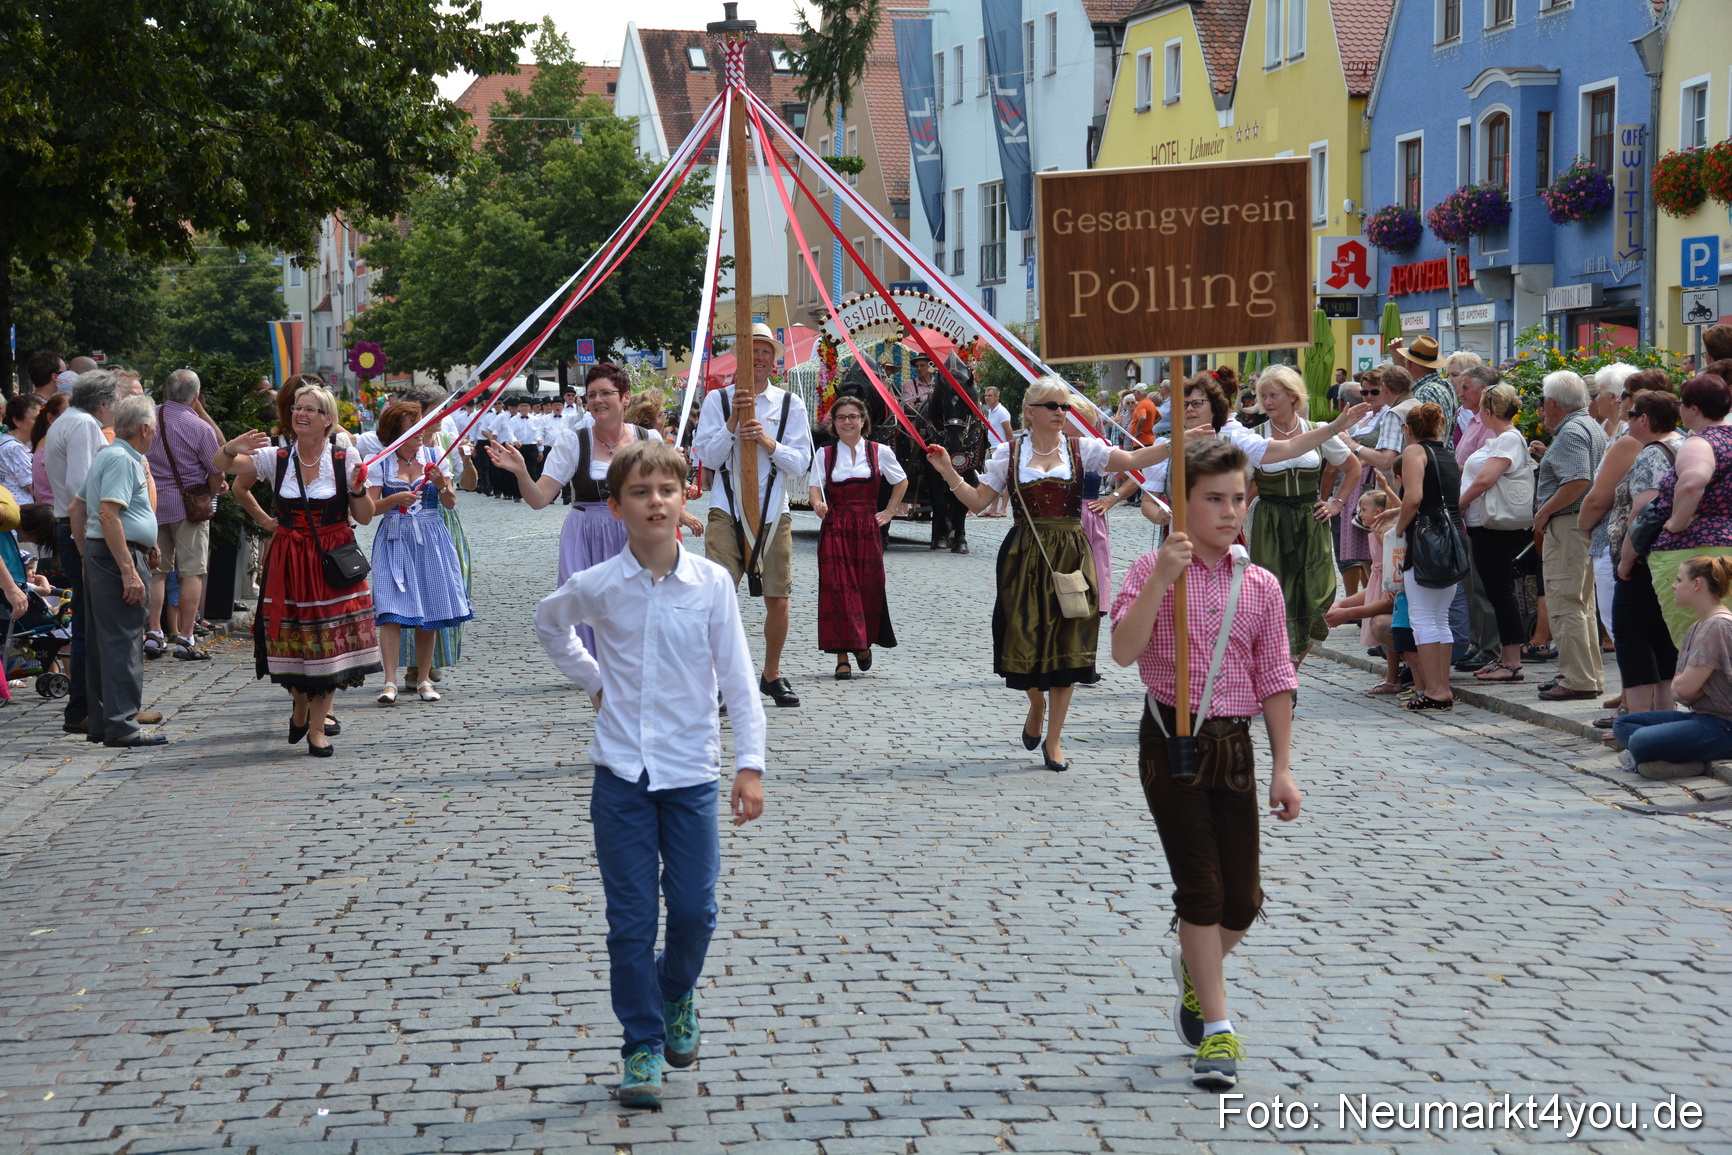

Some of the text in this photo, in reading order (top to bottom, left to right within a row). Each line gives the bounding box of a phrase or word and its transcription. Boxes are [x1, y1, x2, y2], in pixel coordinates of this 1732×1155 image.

[908, 97, 940, 163] K&L
[1151, 133, 1225, 165] HOTEL Lehmeier
[1621, 125, 1645, 146] CAFÉ
[1052, 195, 1295, 235] Gesangverein
[1622, 150, 1642, 248] WITTL
[1388, 254, 1469, 295] APOTHEE
[1689, 243, 1711, 281] P
[1068, 263, 1276, 318] Pölling
[917, 300, 965, 338] Pölling
[1466, 308, 1488, 319] APOTHEKE
